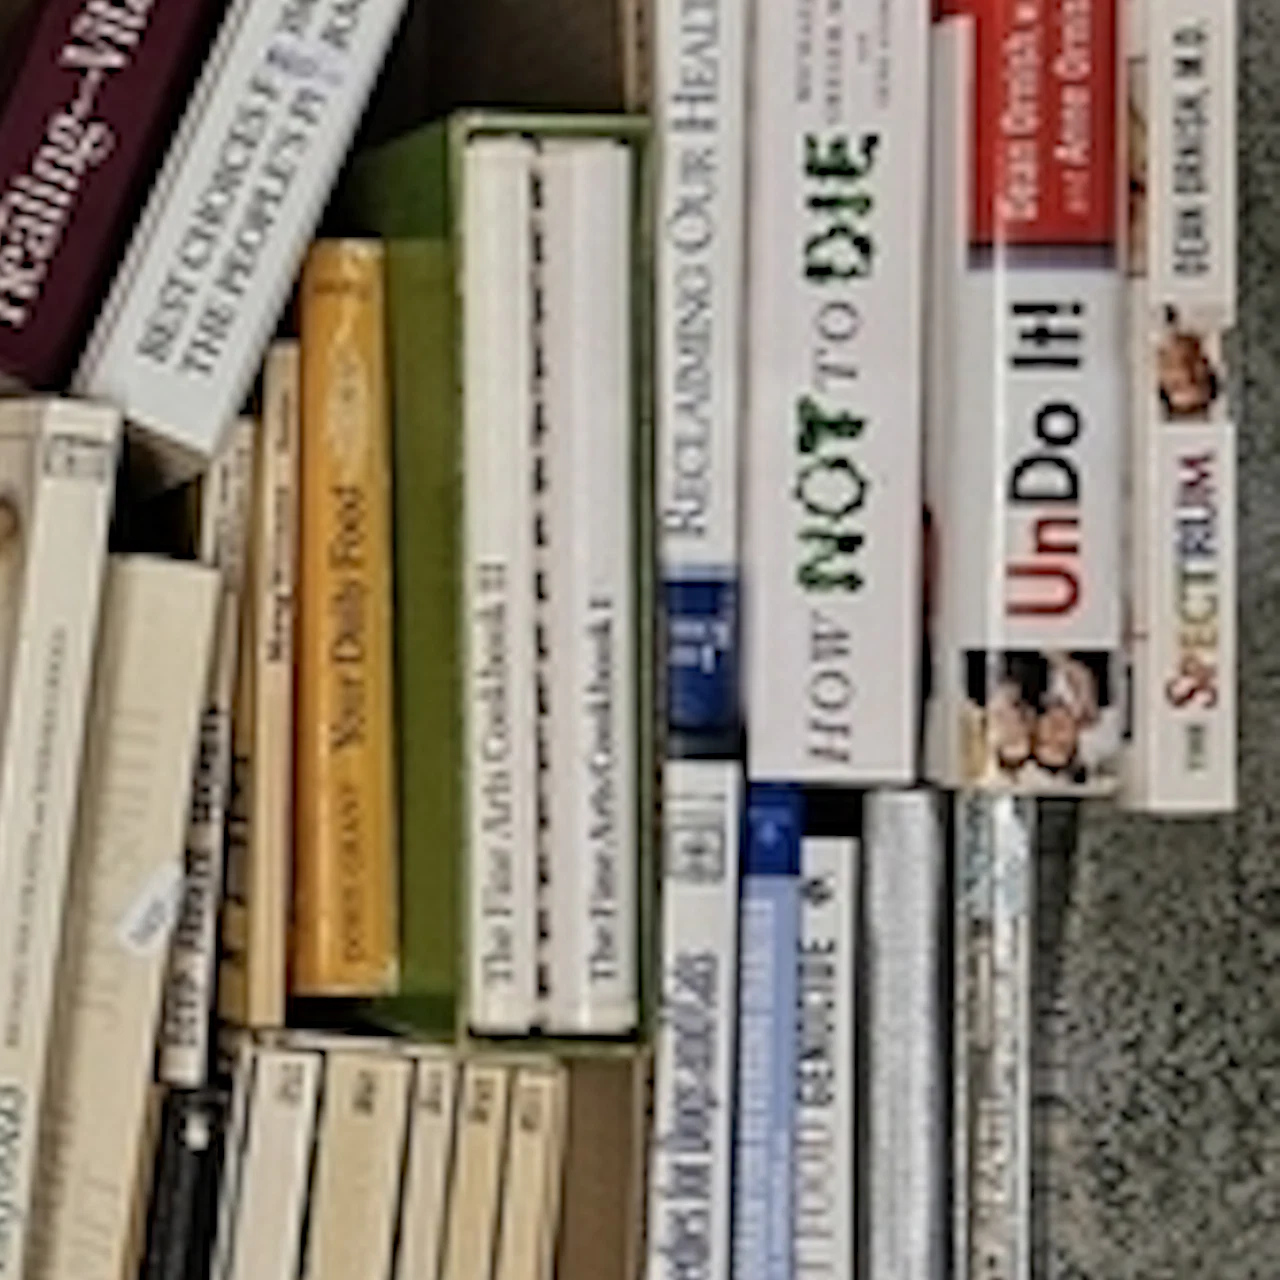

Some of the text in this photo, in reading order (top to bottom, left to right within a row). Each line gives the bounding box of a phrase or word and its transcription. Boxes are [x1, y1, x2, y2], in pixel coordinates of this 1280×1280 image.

[996, 142, 1040, 219] Dean
[1053, 86, 1090, 166] Anne
[136, 271, 198, 366] BEST
[178, 100, 273, 274] CHOICES
[178, 298, 231, 377] THE
[214, 119, 308, 298] PEOPLE'S
[666, 148, 718, 253] OUR
[800, 133, 880, 286] DIE
[1173, 206, 1211, 277] DEAN
[662, 260, 710, 540] RECLAIMING
[811, 300, 858, 391] TO
[790, 395, 868, 595] NOT
[1004, 302, 1083, 617] UnDo It!
[327, 485, 369, 751] Your Daily Food
[1162, 451, 1219, 710] SPECTRUM
[476, 602, 510, 763] Cookbook
[584, 618, 614, 776] Cookbook
[808, 608, 854, 764] HOW
[478, 770, 513, 839] Arts
[586, 777, 615, 842] Arts
[481, 848, 513, 918] Fine
[586, 853, 618, 918] Fine
[479, 925, 513, 986] The
[586, 926, 619, 985] The
[795, 937, 837, 1109] GENOCIDE
[795, 1121, 835, 1250] FOOD
